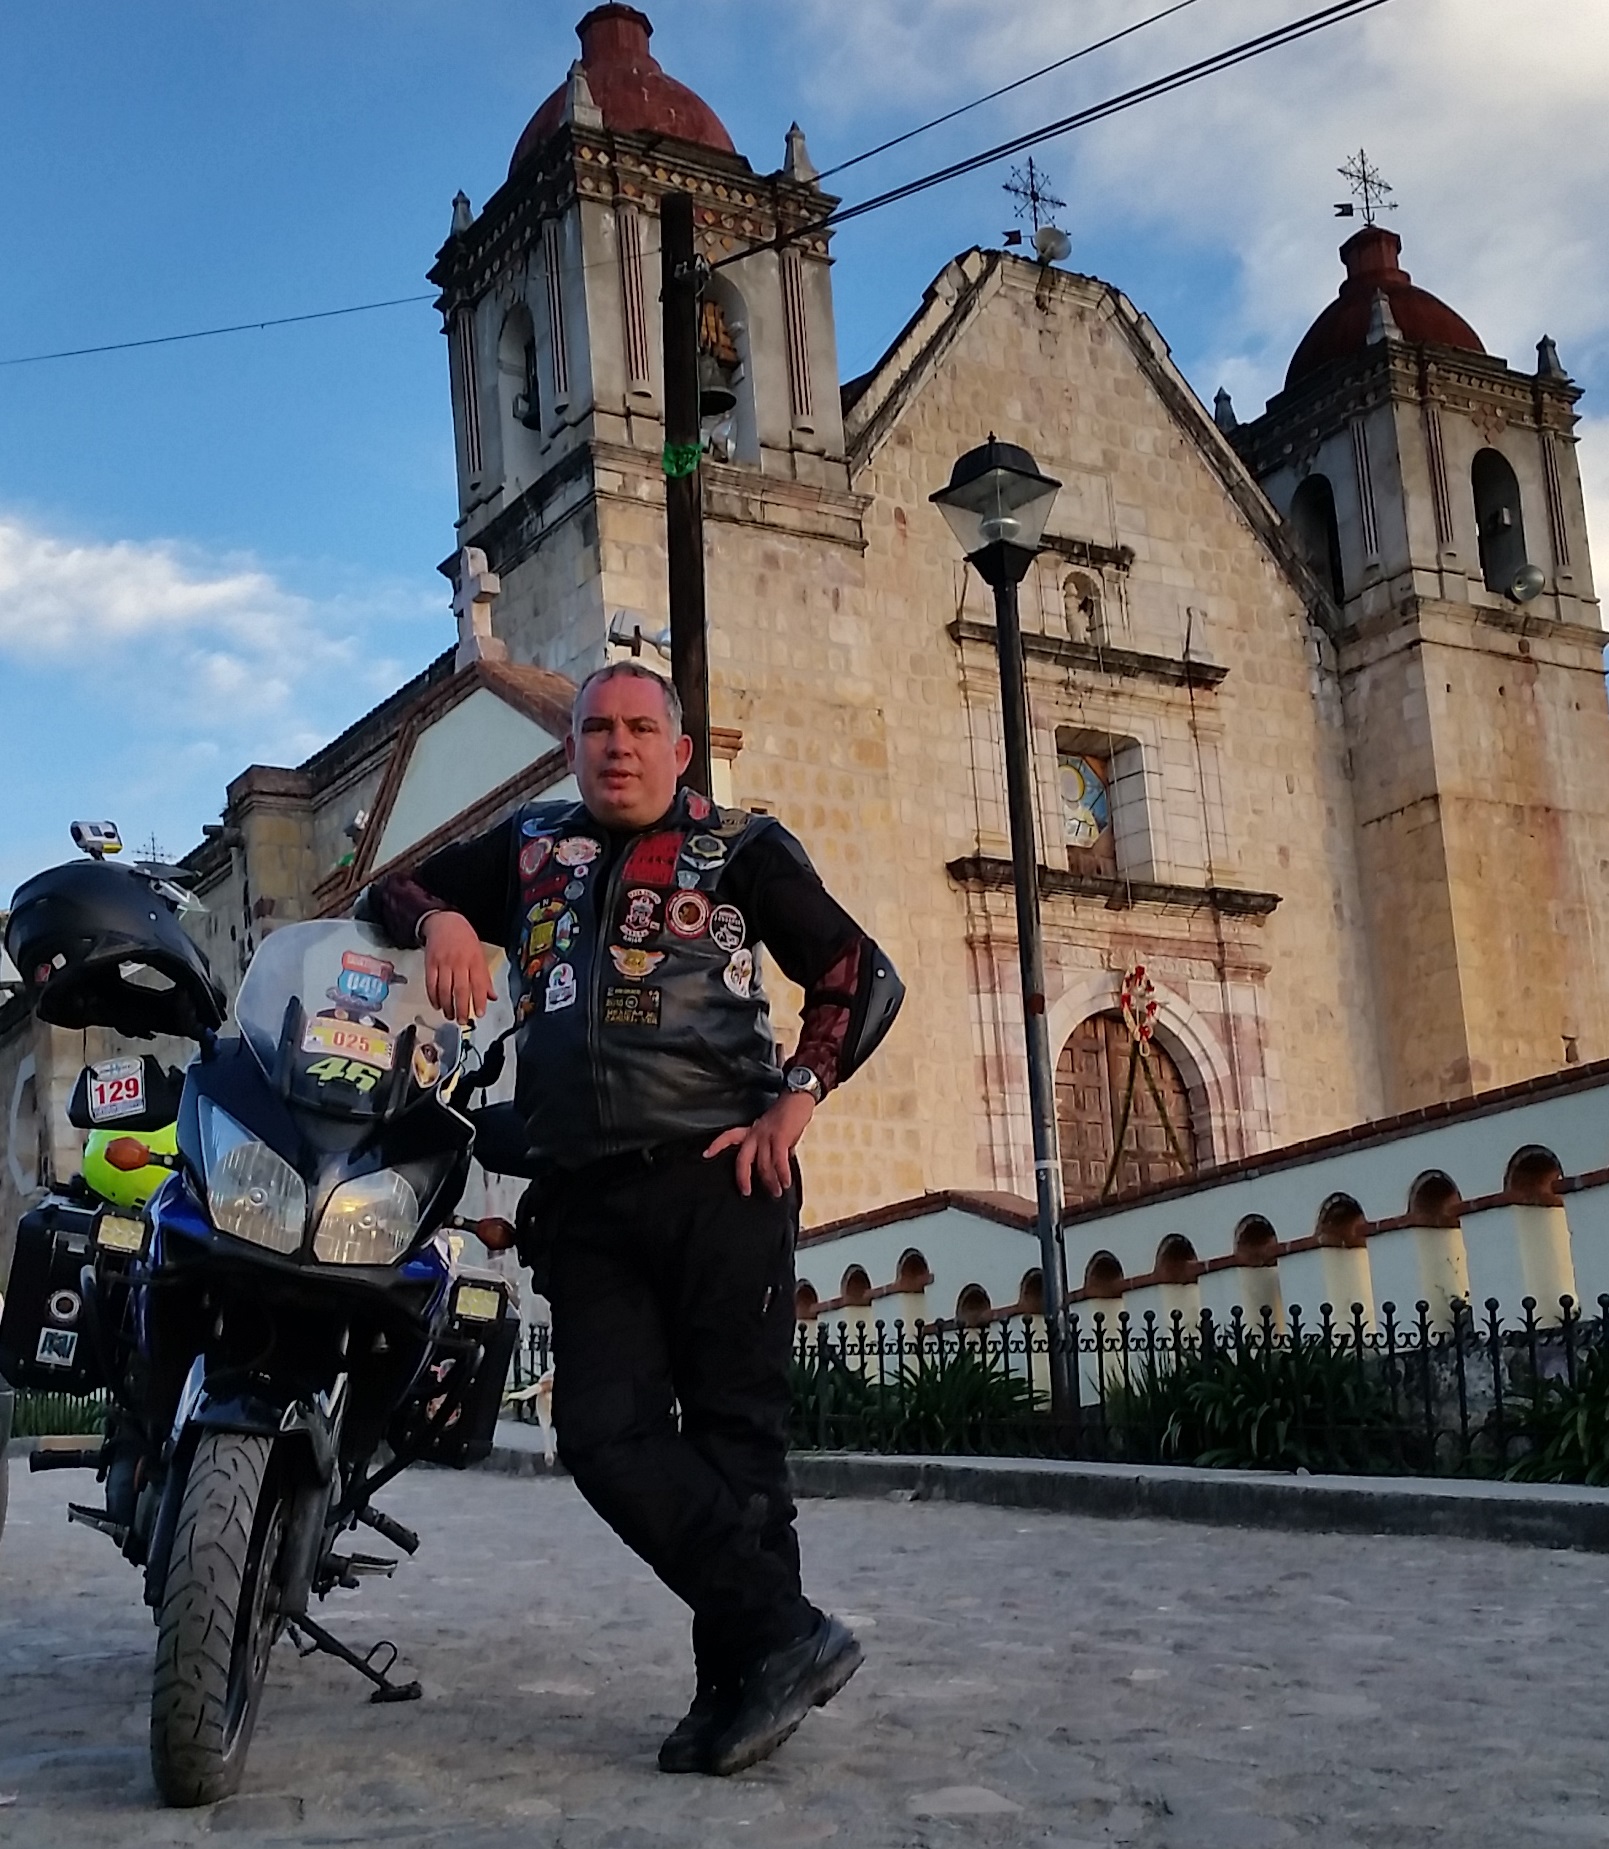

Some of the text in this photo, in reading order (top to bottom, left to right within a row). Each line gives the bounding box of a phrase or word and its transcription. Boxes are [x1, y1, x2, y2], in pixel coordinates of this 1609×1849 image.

[332, 1031, 370, 1053] 025
[305, 1056, 382, 1092] 46
[94, 1077, 140, 1105] 129
